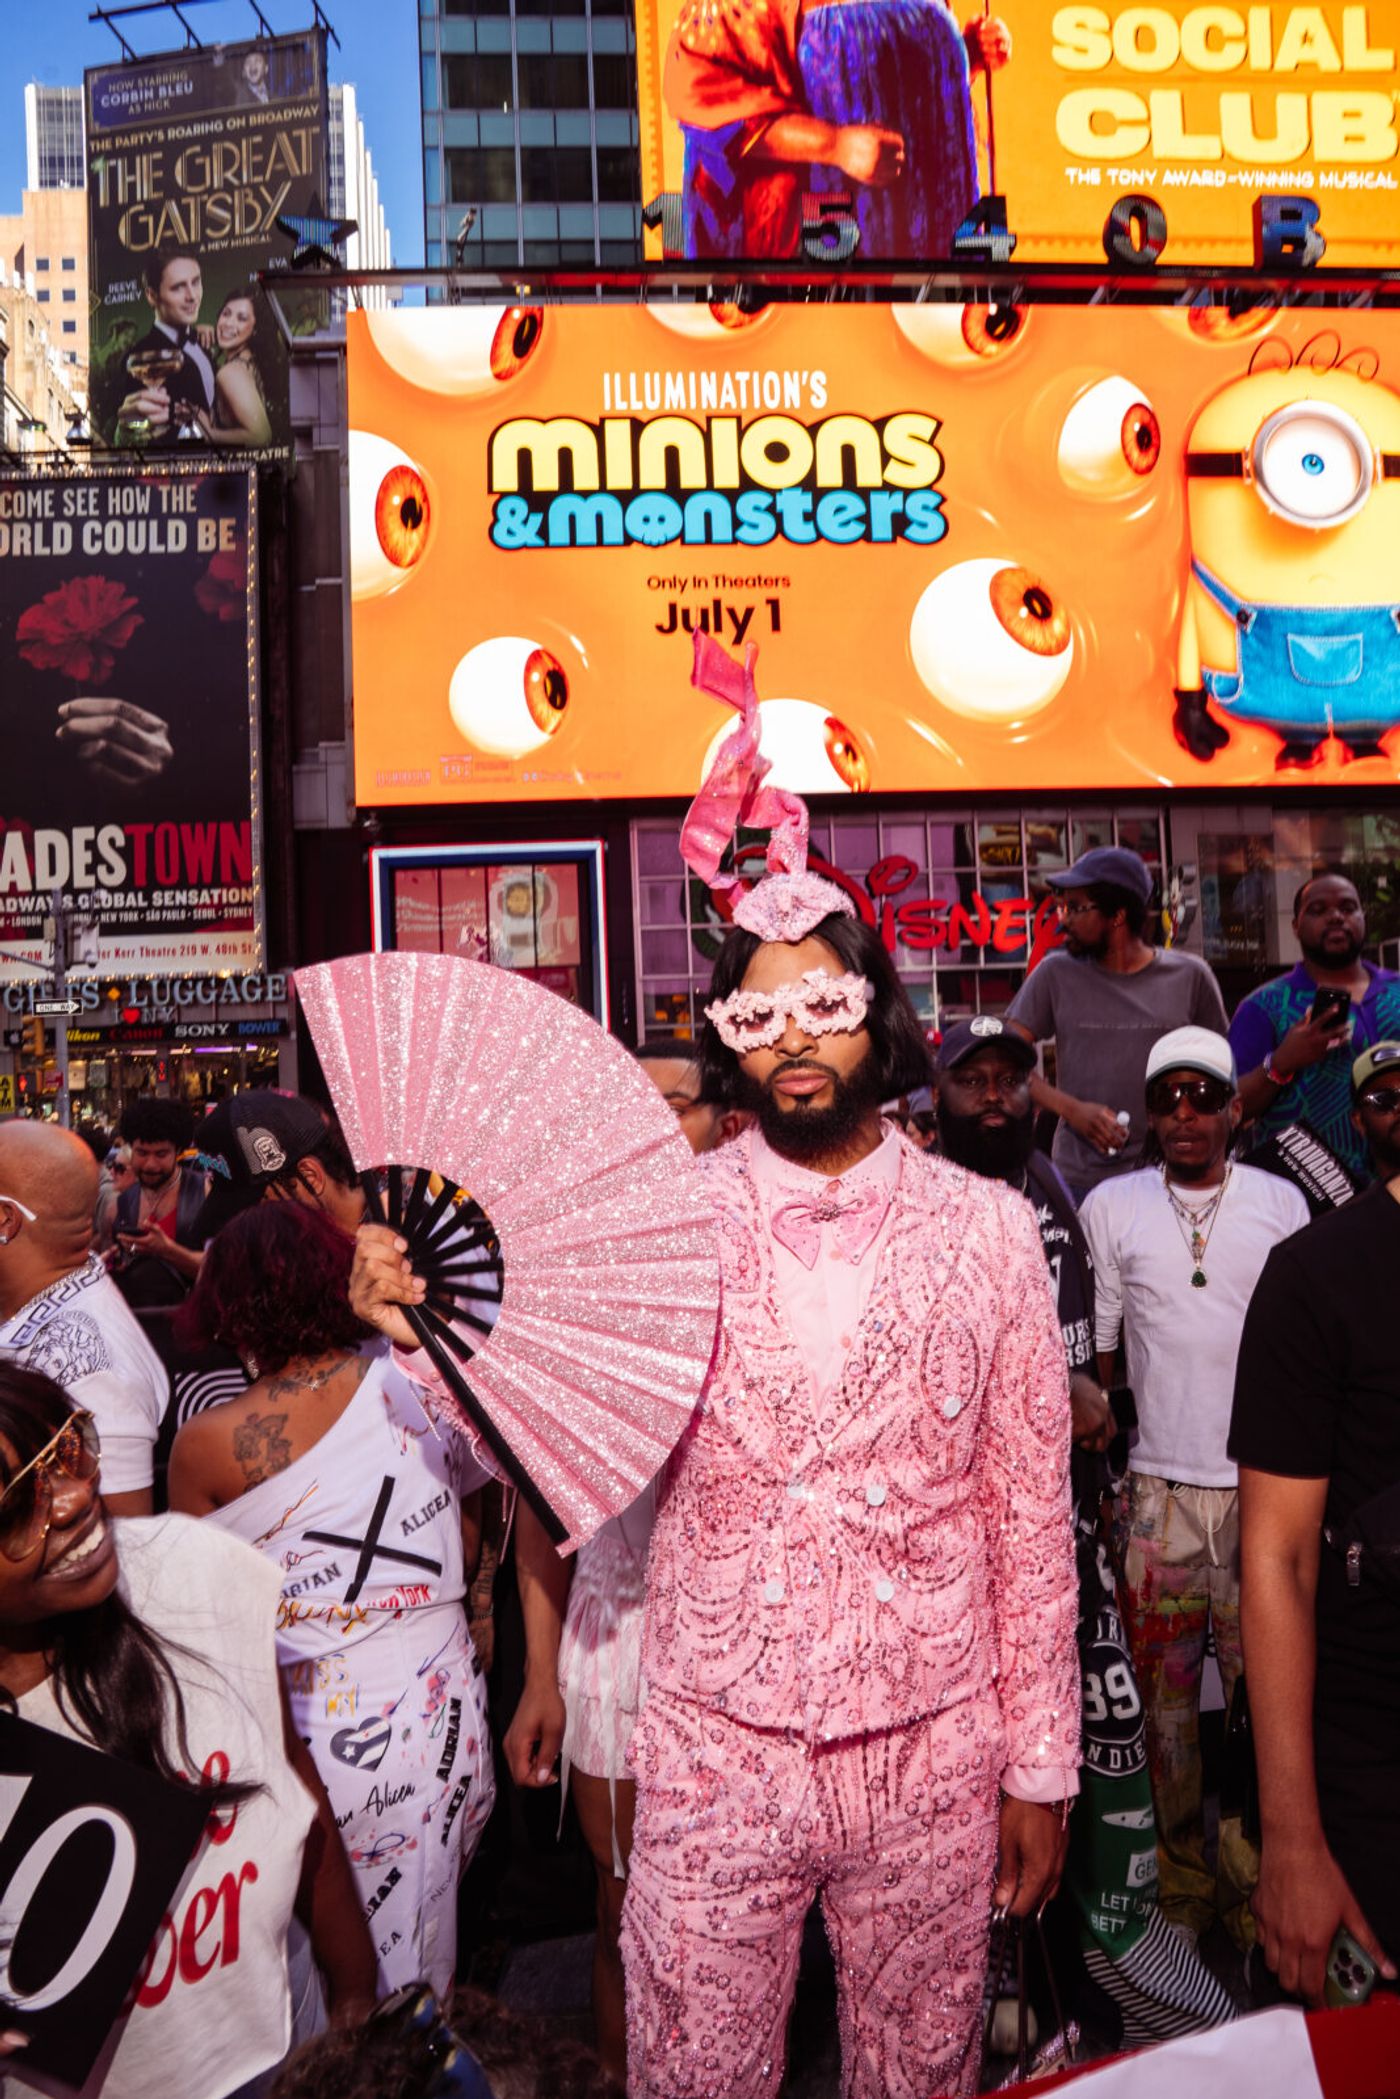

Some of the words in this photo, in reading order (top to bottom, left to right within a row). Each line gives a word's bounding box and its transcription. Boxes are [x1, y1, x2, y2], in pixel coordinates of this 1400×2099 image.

[1051, 4, 1395, 73] SOCIAL
[101, 86, 154, 108] CORBIN
[159, 80, 194, 99] BLEU
[108, 80, 134, 94] NOW
[137, 71, 189, 88] STARRING
[90, 138, 112, 152] THE
[115, 130, 165, 151] PARTY'S
[167, 120, 223, 140] ROARING
[226, 116, 246, 129] ON
[249, 104, 320, 123] BROADWAY
[1054, 88, 1396, 164] CLUB
[92, 151, 164, 208] THE
[174, 127, 320, 193] GREAT
[1065, 168, 1101, 186] THE
[1106, 168, 1157, 186] TONY
[1161, 169, 1314, 189] AWARD-WINNING
[1319, 171, 1398, 190] MUSICAL
[118, 180, 292, 252] GATSBY
[268, 256, 288, 270] EVA
[104, 290, 142, 307] CARNEY
[602, 370, 828, 411] ILLUMINATION'S
[487, 412, 945, 494] minions
[1, 488, 55, 518] COME
[63, 487, 100, 517] SEE
[108, 485, 151, 516] HOW
[159, 484, 197, 513] THE
[82, 518, 187, 556] COULD
[197, 517, 238, 553] BE
[646, 574, 691, 593] Only
[712, 573, 792, 591] Theaters
[655, 598, 755, 645] July
[768, 599, 784, 633] 1
[152, 886, 252, 908] SENSATION
[11, 915, 42, 928] LONDON
[101, 911, 117, 923] NEW
[118, 910, 140, 922] YORK
[162, 908, 186, 921] PAULO
[192, 906, 217, 920] SEOUL
[223, 906, 253, 919] SYDNEY
[140, 944, 177, 958] Theatre
[129, 974, 288, 1007] LUGGAGE
[38, 1003, 56, 1013] ONE
[59, 1002, 76, 1012] WAY
[141, 1005, 176, 1025] NY
[109, 1026, 164, 1041] Canon
[174, 1023, 229, 1037] SONY
[238, 1021, 281, 1035] BOWER
[400, 1488, 451, 1537] ALICEA
[436, 1697, 462, 1784] ADRIAN
